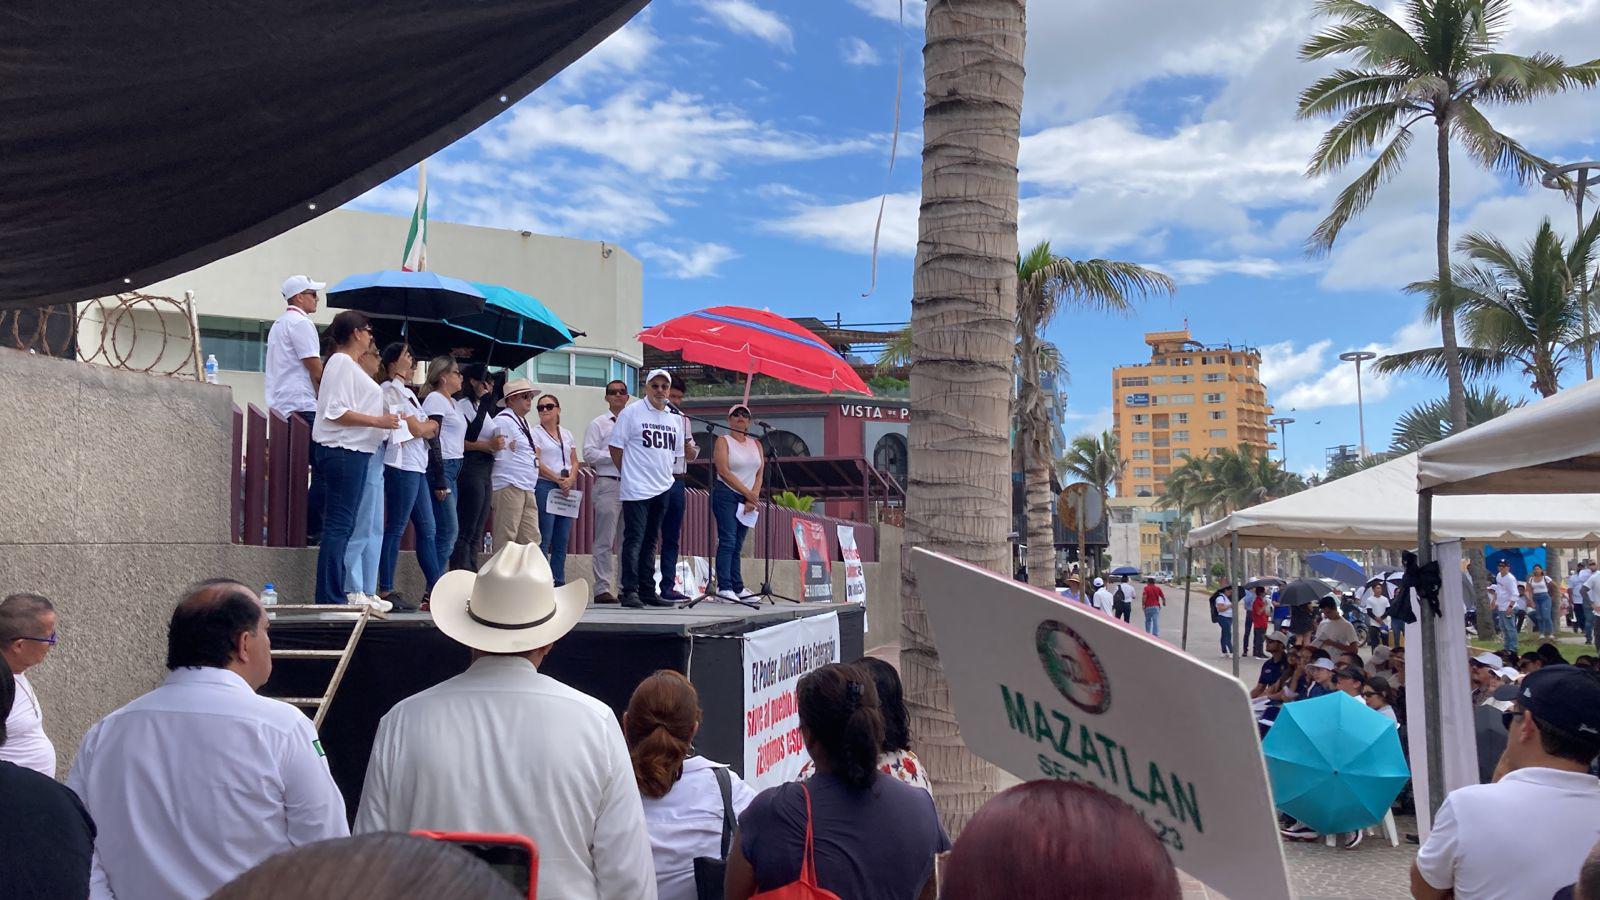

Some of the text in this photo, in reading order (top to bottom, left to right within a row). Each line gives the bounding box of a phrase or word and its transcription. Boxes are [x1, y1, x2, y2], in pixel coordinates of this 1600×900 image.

[841, 404, 882, 418] VISTA
[901, 408, 911, 420] P
[642, 430, 676, 451] SCJN
[752, 662, 758, 693] El
[760, 657, 777, 690] Poder
[778, 647, 801, 682] Judicial
[771, 690, 792, 730] pueblo
[1000, 683, 1204, 834] MAZATLAN
[1154, 819, 1184, 851] 23
